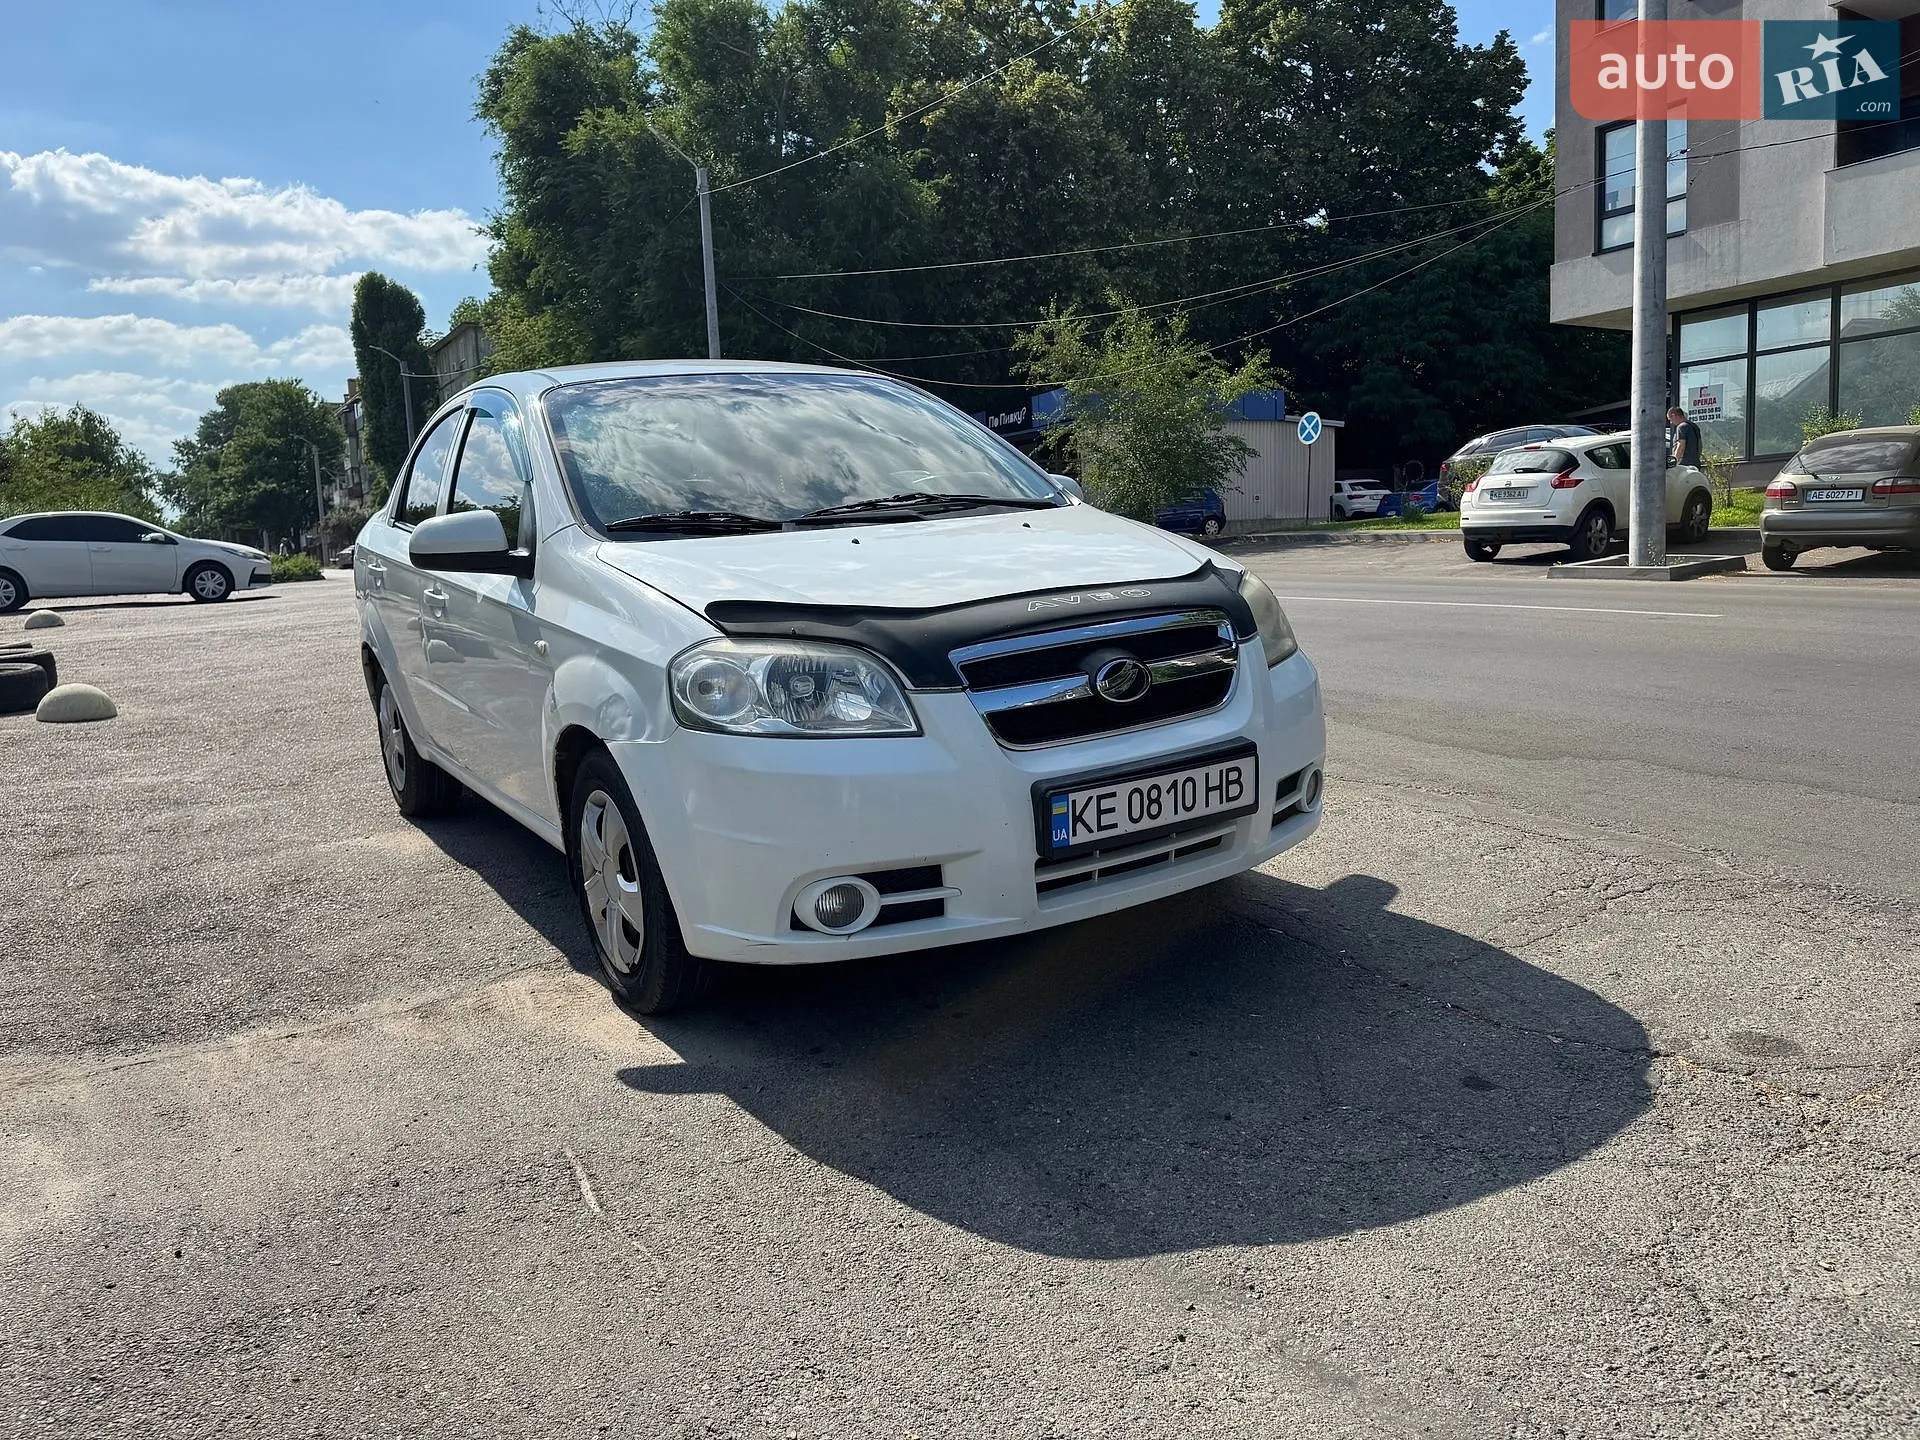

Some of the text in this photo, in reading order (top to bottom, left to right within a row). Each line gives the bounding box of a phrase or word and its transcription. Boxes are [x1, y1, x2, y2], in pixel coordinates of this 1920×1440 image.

[1693, 397, 1717, 406] ОРЕНДА
[1812, 491, 1823, 500] AE
[1825, 490, 1844, 499] 6027
[1027, 588, 1152, 612] AVEO
[1071, 766, 1244, 837] KE 0810 HB
[1052, 828, 1068, 841] UA
